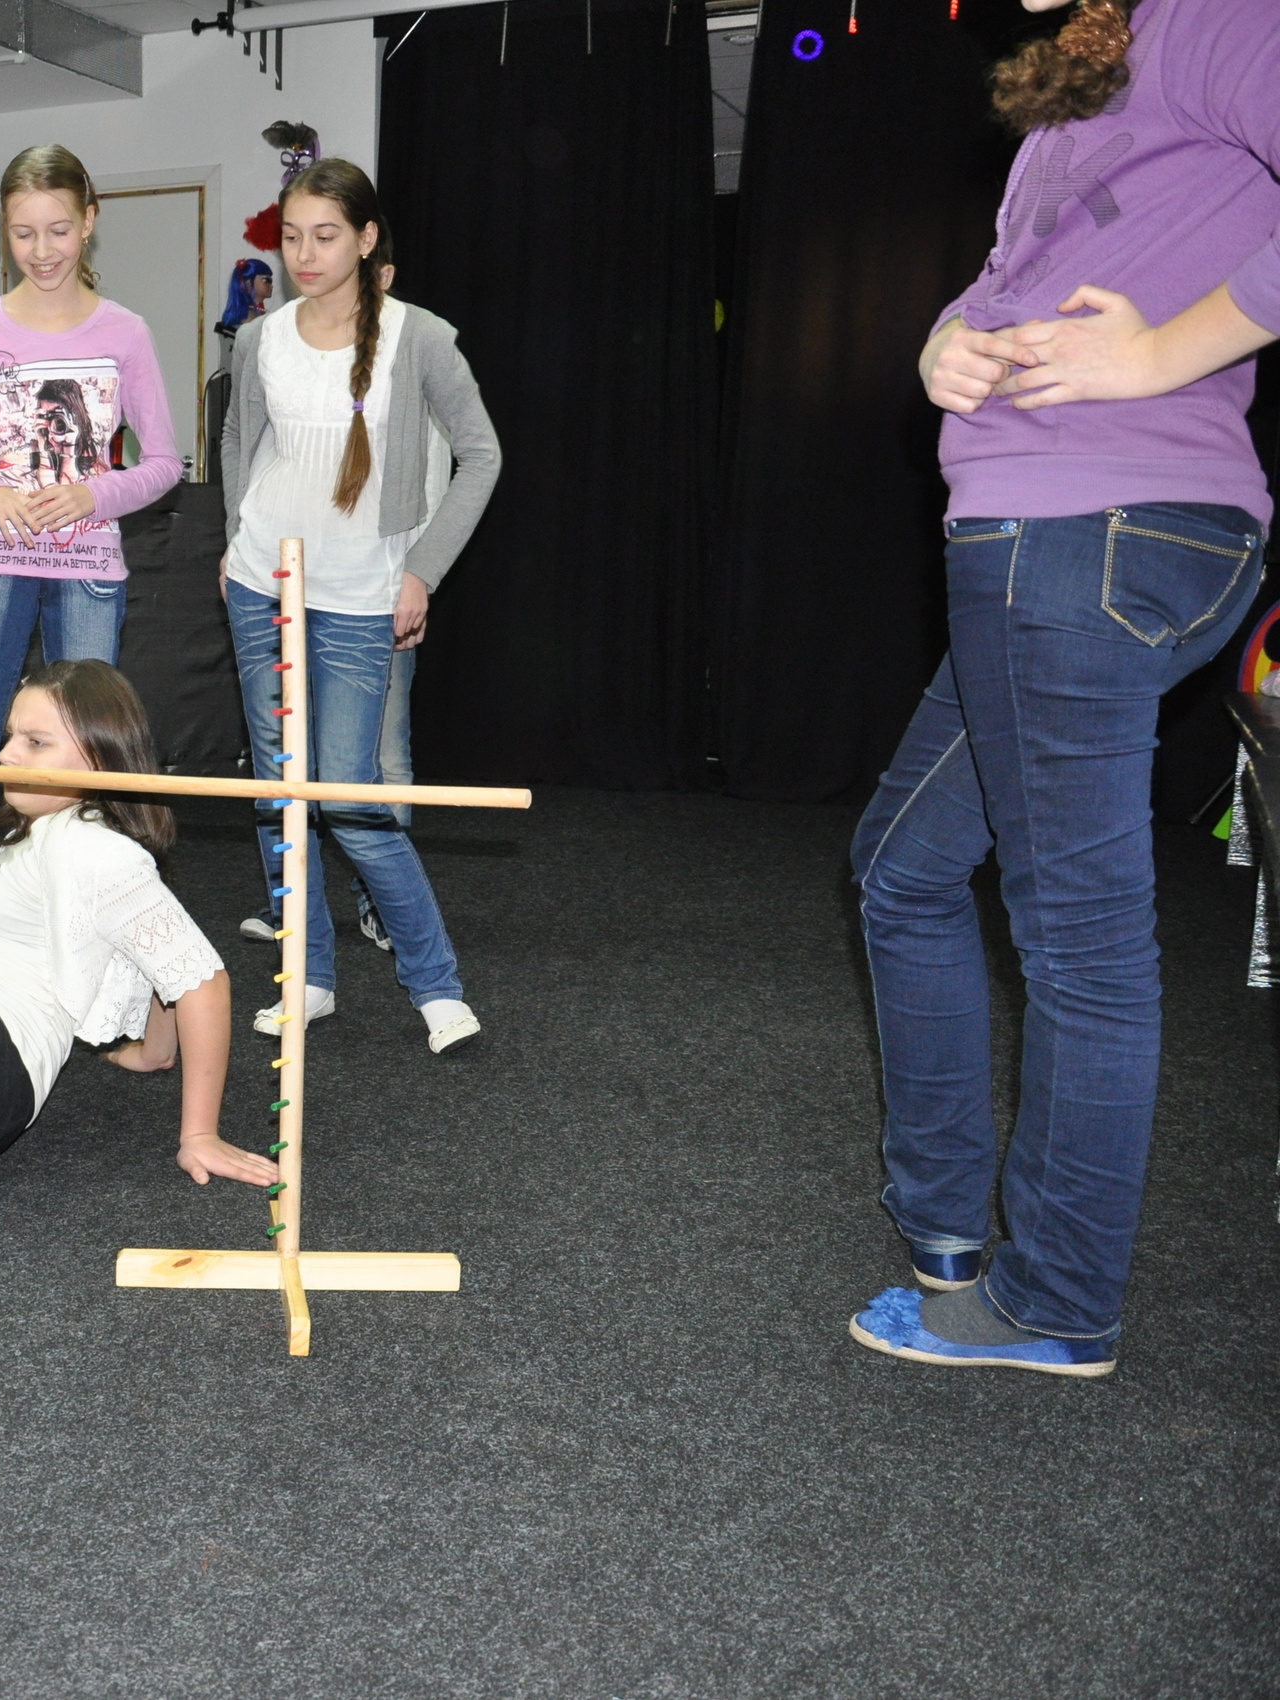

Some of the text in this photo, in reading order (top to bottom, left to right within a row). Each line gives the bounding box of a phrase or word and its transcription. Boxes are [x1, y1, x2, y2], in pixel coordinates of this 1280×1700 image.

[43, 542, 47, 553] I
[73, 543, 97, 556] WANT
[101, 546, 111, 558] TO
[12, 555, 27, 566] THE
[28, 556, 51, 567] FAITH
[52, 557, 61, 568] IN
[62, 559, 69, 568] A
